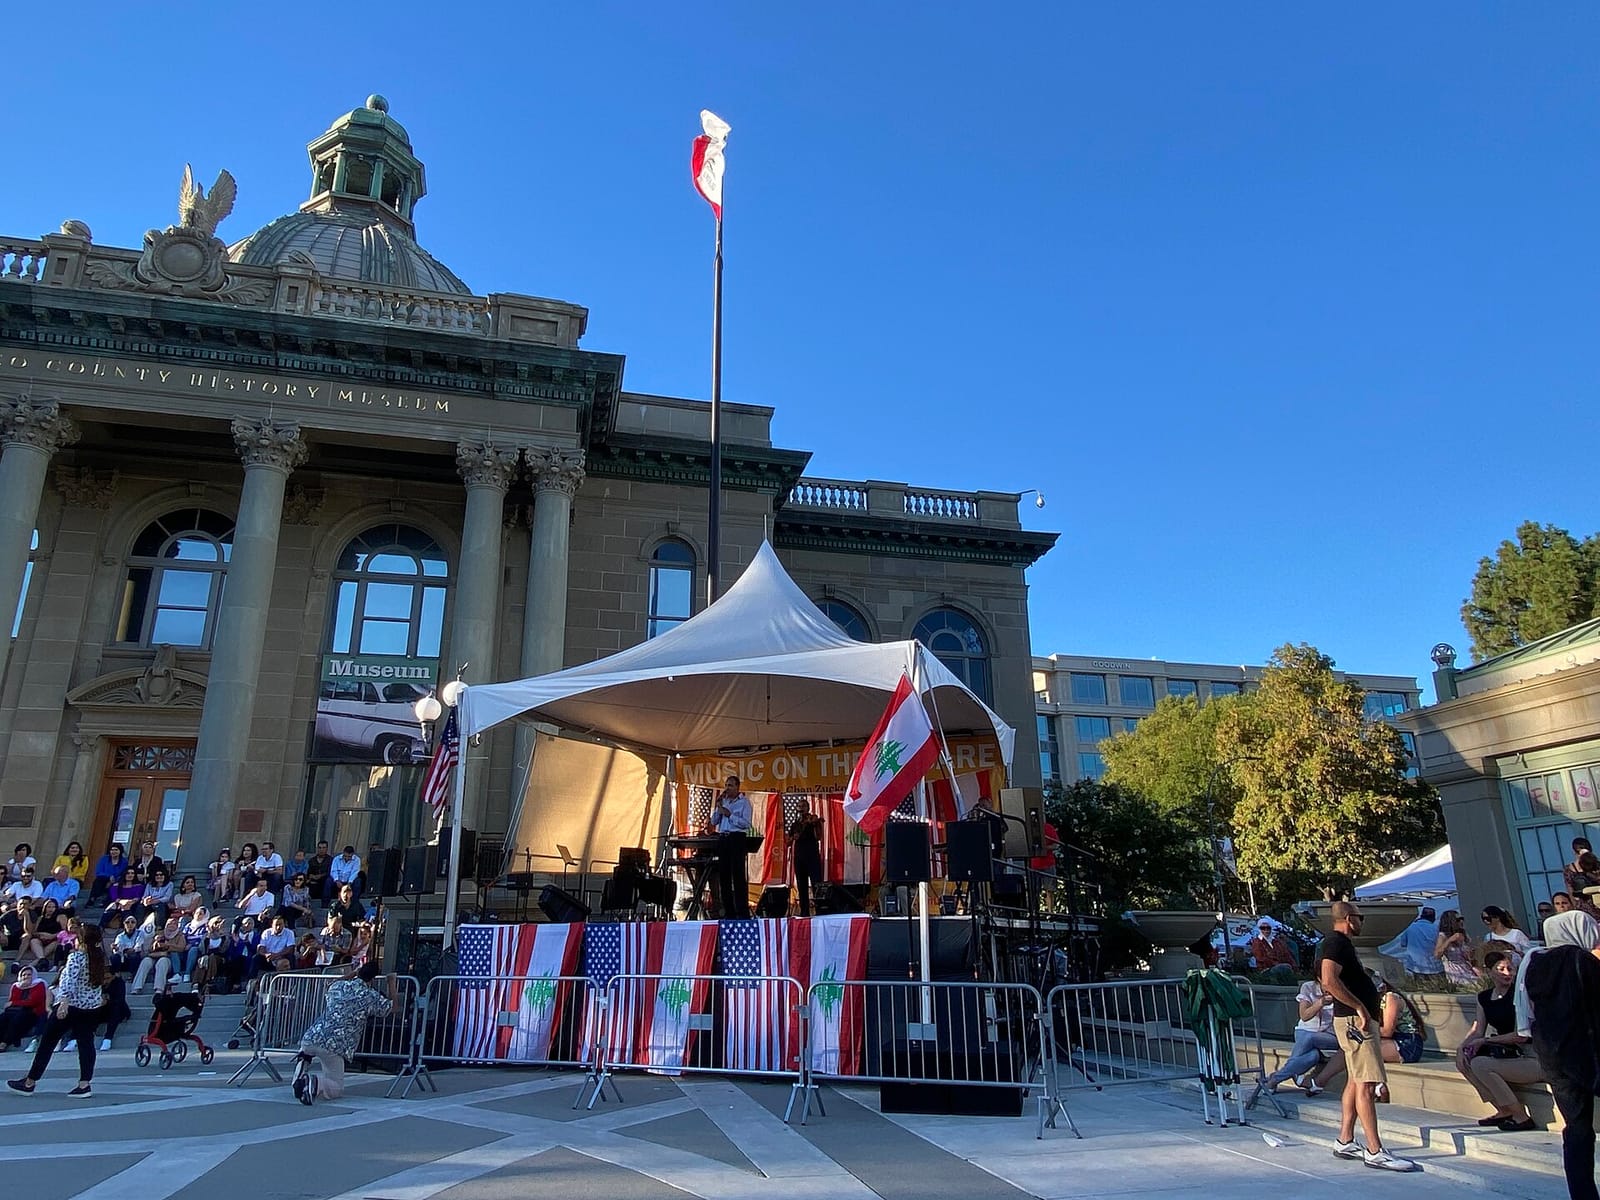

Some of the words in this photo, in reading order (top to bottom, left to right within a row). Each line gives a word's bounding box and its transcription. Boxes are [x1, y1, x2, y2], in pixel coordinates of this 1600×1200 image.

[46, 359, 172, 383] COUNTY
[190, 373, 319, 399] HISTORY
[338, 389, 449, 413] MUSEUM
[329, 659, 430, 678] Museum
[1092, 660, 1131, 670] GOODWIN
[682, 760, 765, 786] MUSIC
[771, 754, 809, 780] ON
